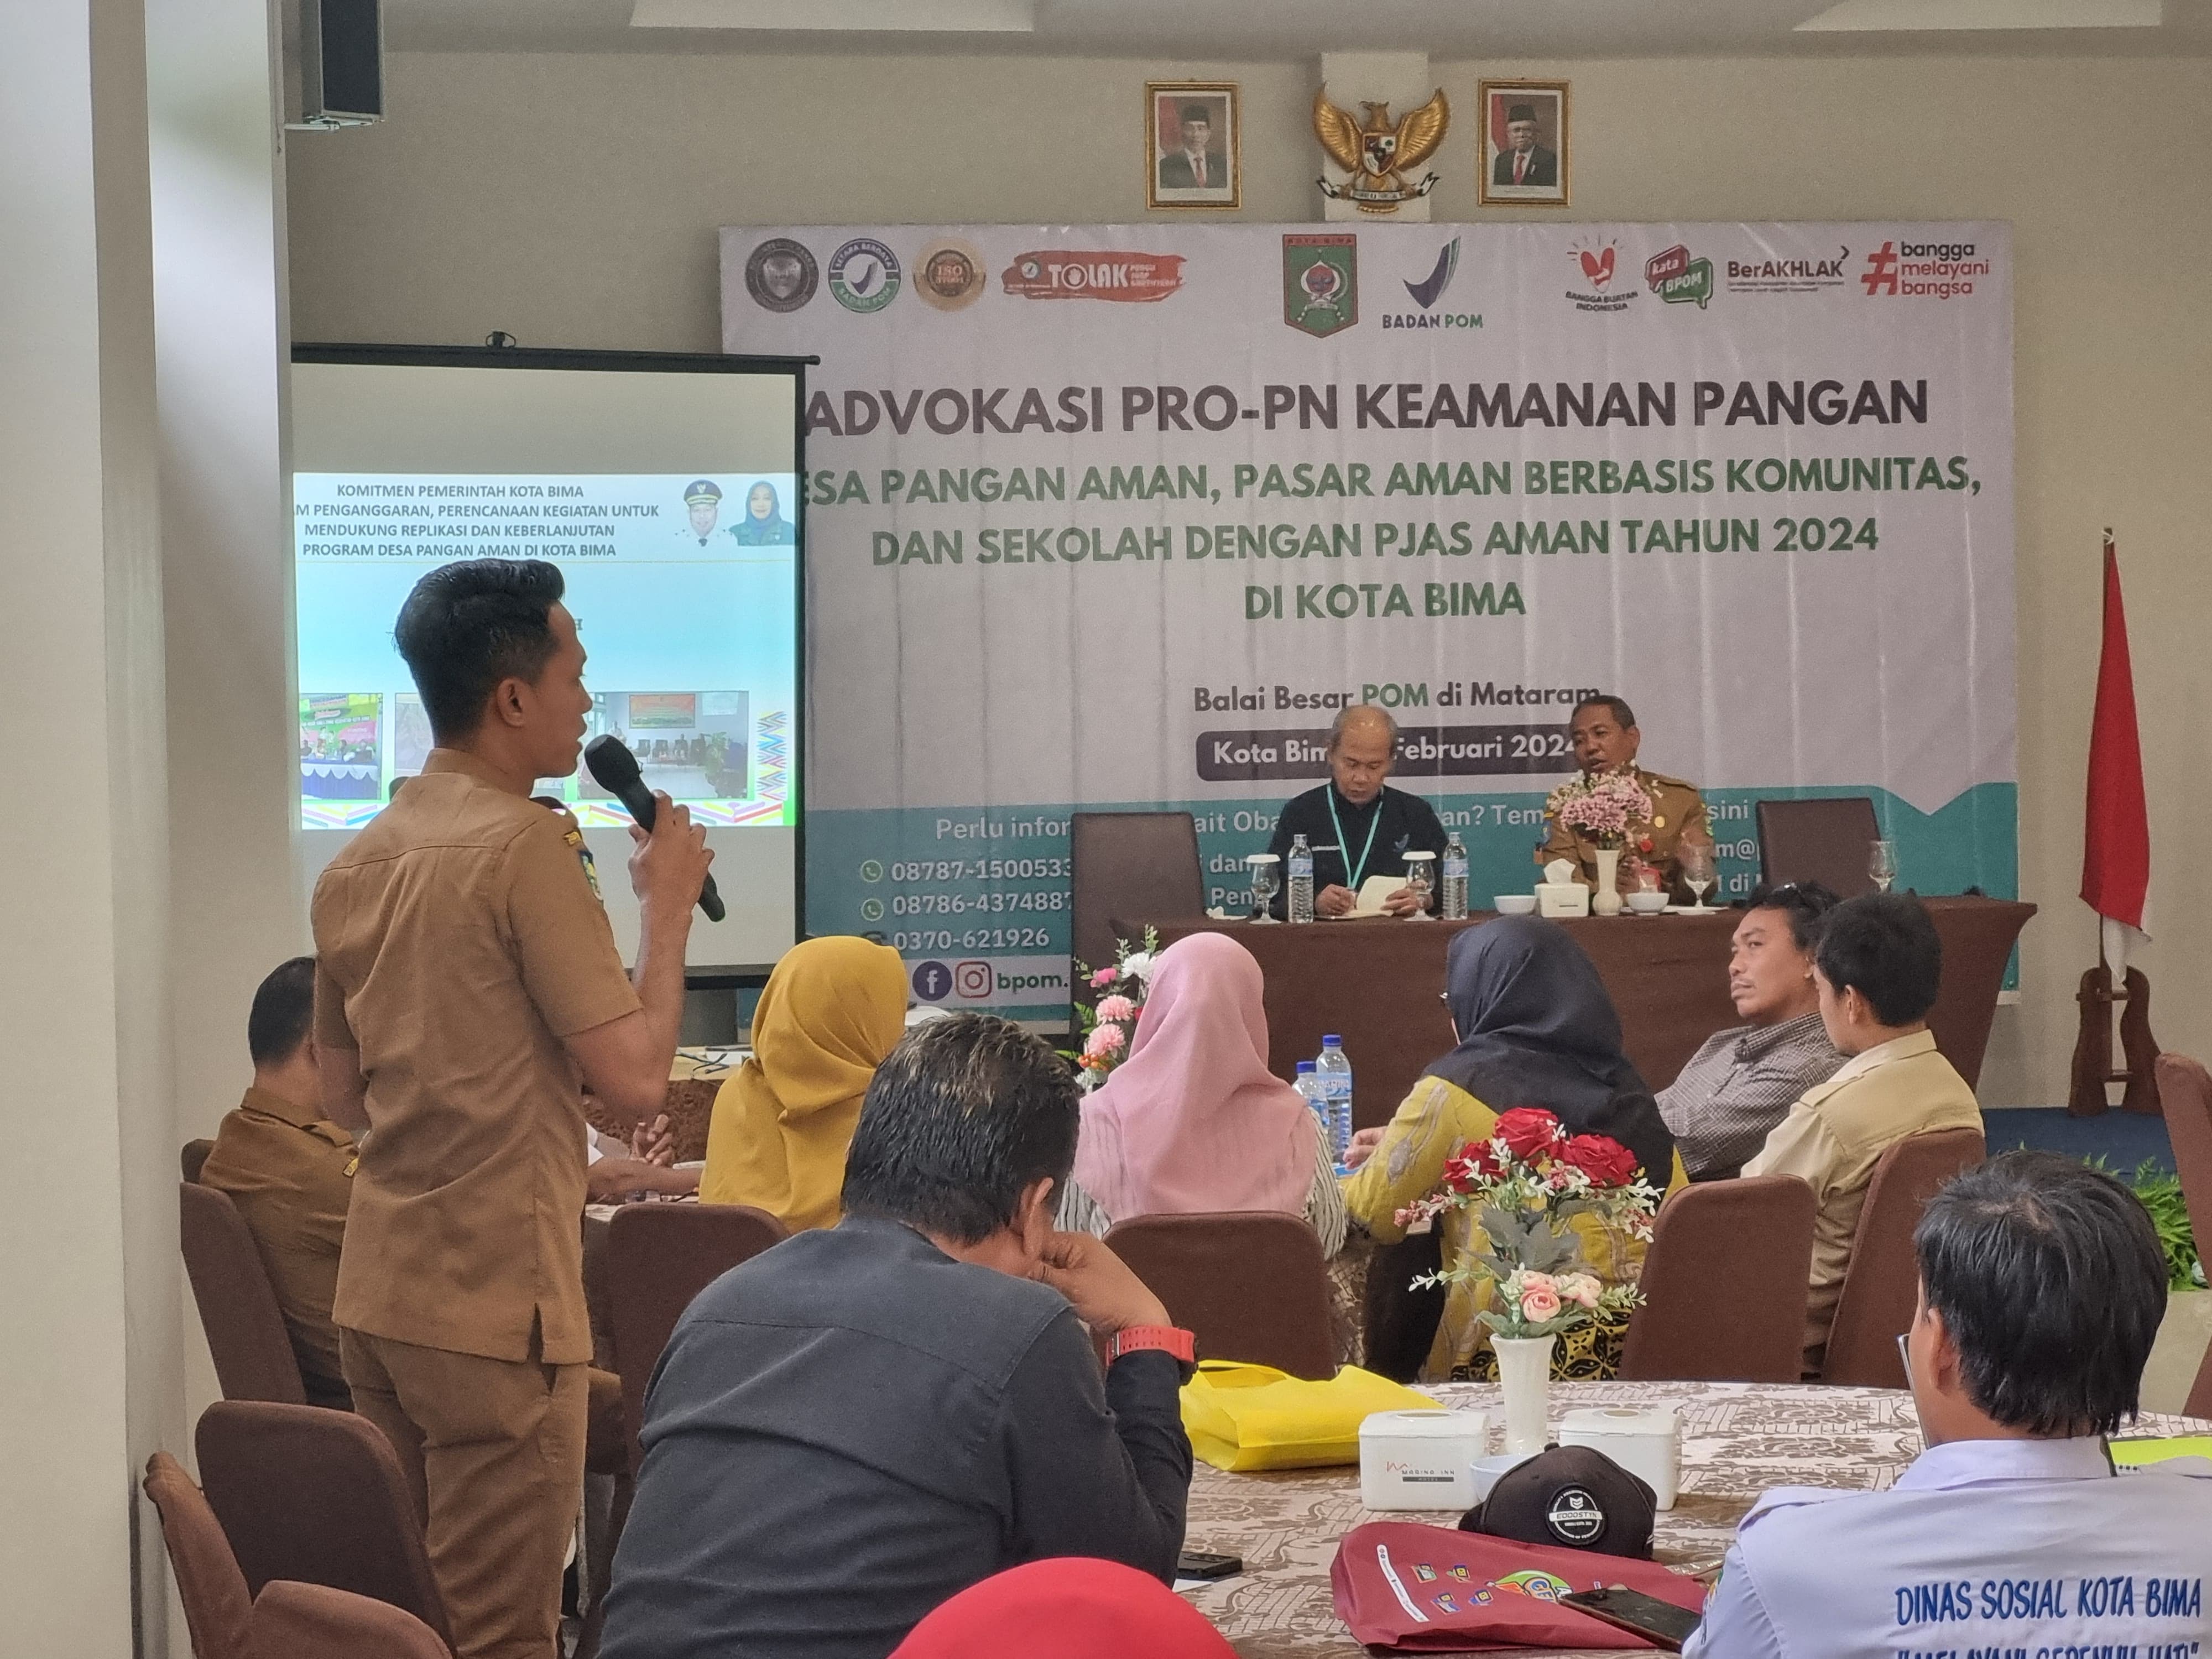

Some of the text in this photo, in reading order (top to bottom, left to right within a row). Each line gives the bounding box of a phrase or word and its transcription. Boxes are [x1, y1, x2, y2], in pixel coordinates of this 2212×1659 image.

[1901, 241, 1975, 261] bangga
[1652, 258, 1679, 275] kata
[1728, 260, 1843, 278] BerAKHLAK
[1902, 259, 1989, 280] melayani
[1666, 271, 1702, 292] BPOM
[1901, 280, 1973, 300] bangsa
[1566, 291, 1639, 302] BANGGA BUATAN
[1577, 303, 1628, 312] INDONESIA
[1383, 314, 1483, 328] BADAN POM
[806, 379, 1927, 436] ADVOKASI PRO-PN KEAMANAN PANGAN
[337, 484, 584, 497] KOMITMEN PEMERINTAH KOTA BIMA
[805, 456, 1981, 505] SA PANGAN AMAN, PASAR AMAN BERBASIS KOMUNITAS,
[314, 504, 434, 519] PENGANGGARAN,
[438, 505, 539, 517] PERENCANAAN
[543, 505, 608, 517] KEGIATAN
[612, 505, 659, 517] UNTUK
[305, 524, 615, 536] MENDUKUNG REPLIKASI DAN KEBERLANJUTAN
[303, 544, 616, 556] PROGRAM DESA PANGAN AMAN DI KOTA BIMA
[872, 517, 1879, 566] DAN SEKOLAH DENGAN PJAS AMAN TAHUN 2024
[1245, 582, 1526, 619] DI KOTA BIMA
[1194, 686, 1265, 712] Balai
[1274, 686, 1354, 710] Besar
[1362, 683, 1428, 708] POM
[1437, 682, 1462, 706] di
[1214, 741, 1277, 764] Kota
[1285, 739, 1328, 762] Bim
[936, 817, 1003, 840] Perlu
[1730, 873, 1749, 893] di
[893, 928, 1050, 951] 0370-621926
[1895, 1576, 2201, 1625] DINAS SOSIAL KOTA BIMA
